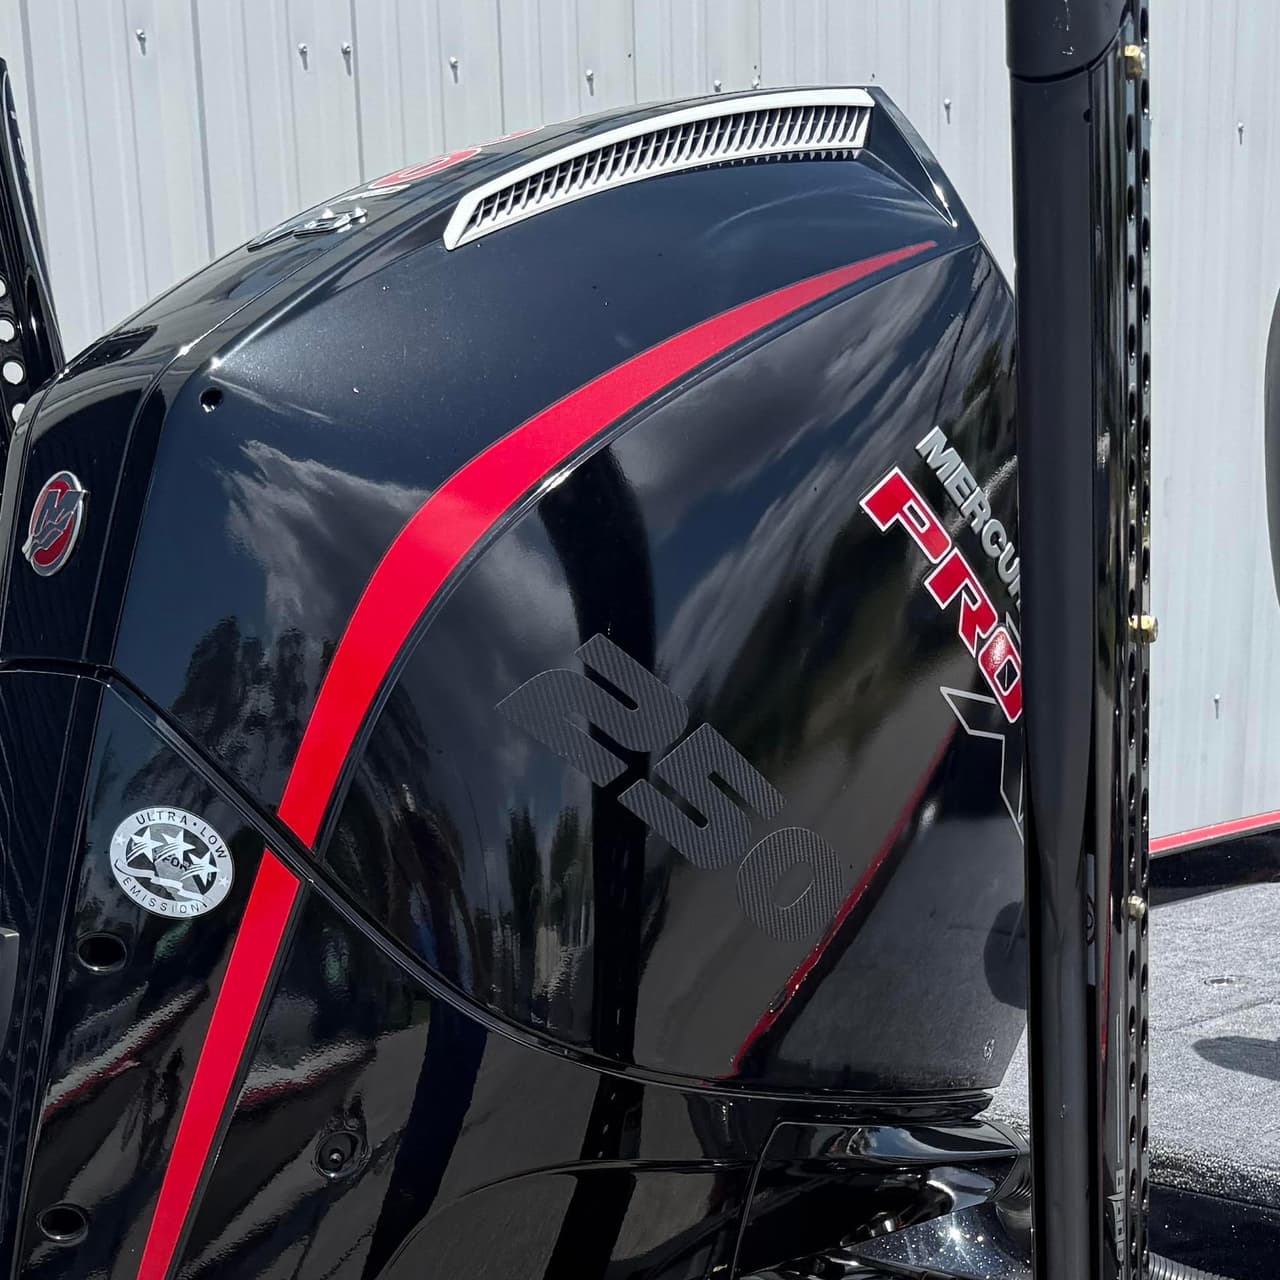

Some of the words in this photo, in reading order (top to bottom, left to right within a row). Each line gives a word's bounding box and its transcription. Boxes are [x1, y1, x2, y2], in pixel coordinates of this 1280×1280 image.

[859, 466, 1023, 724] PRO
[135, 811, 187, 826] ULTRA
[200, 826, 227, 859] LOW
[495, 632, 843, 942] 250
[122, 876, 200, 914] EMISSION
